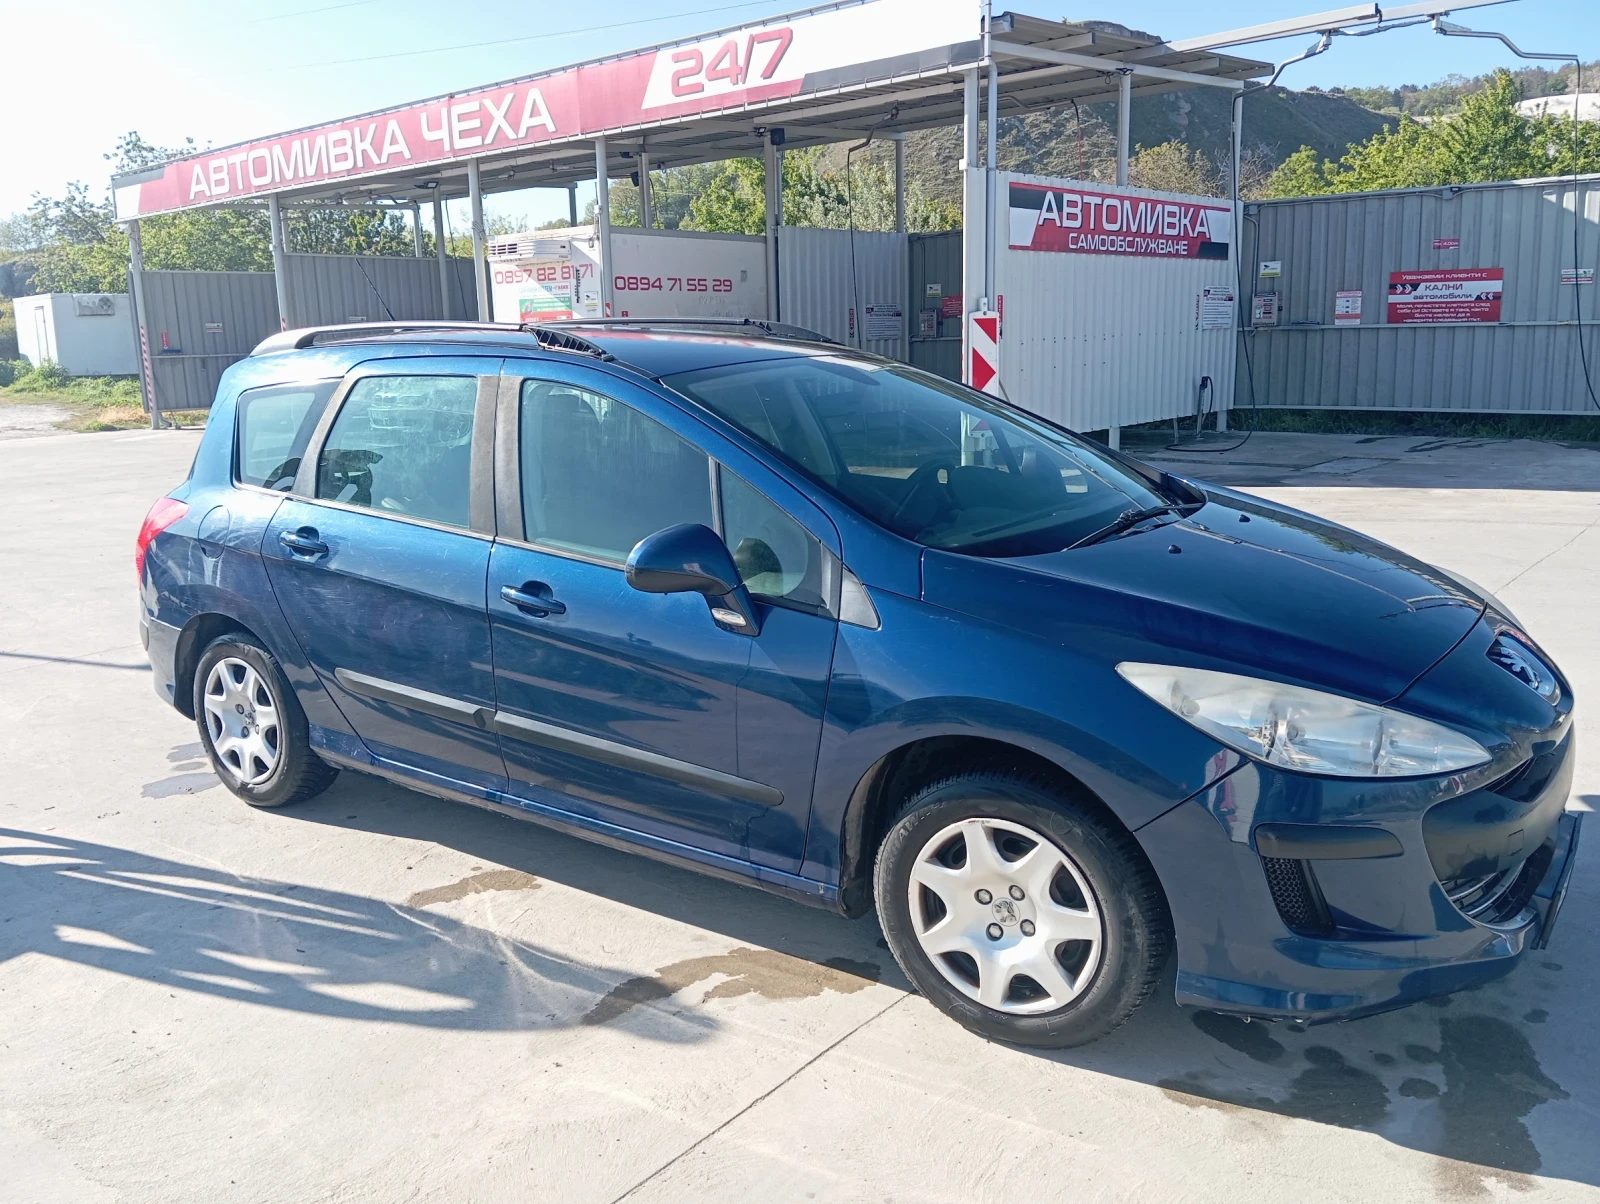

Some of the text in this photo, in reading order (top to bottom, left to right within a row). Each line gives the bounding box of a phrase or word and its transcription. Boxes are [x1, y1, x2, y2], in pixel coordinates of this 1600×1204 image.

[671, 27, 793, 97] 24/7
[189, 88, 556, 200] АВТОМИВКА ЧЕХА
[1038, 191, 1211, 239] АВТОМИВКА
[1068, 232, 1188, 255] САМООБСЛУЖВАНЕ
[494, 268, 533, 285] 0897
[536, 266, 556, 282] 82
[614, 276, 733, 292] 0894 71 55 29
[1424, 283, 1463, 292] КАЛНИ
